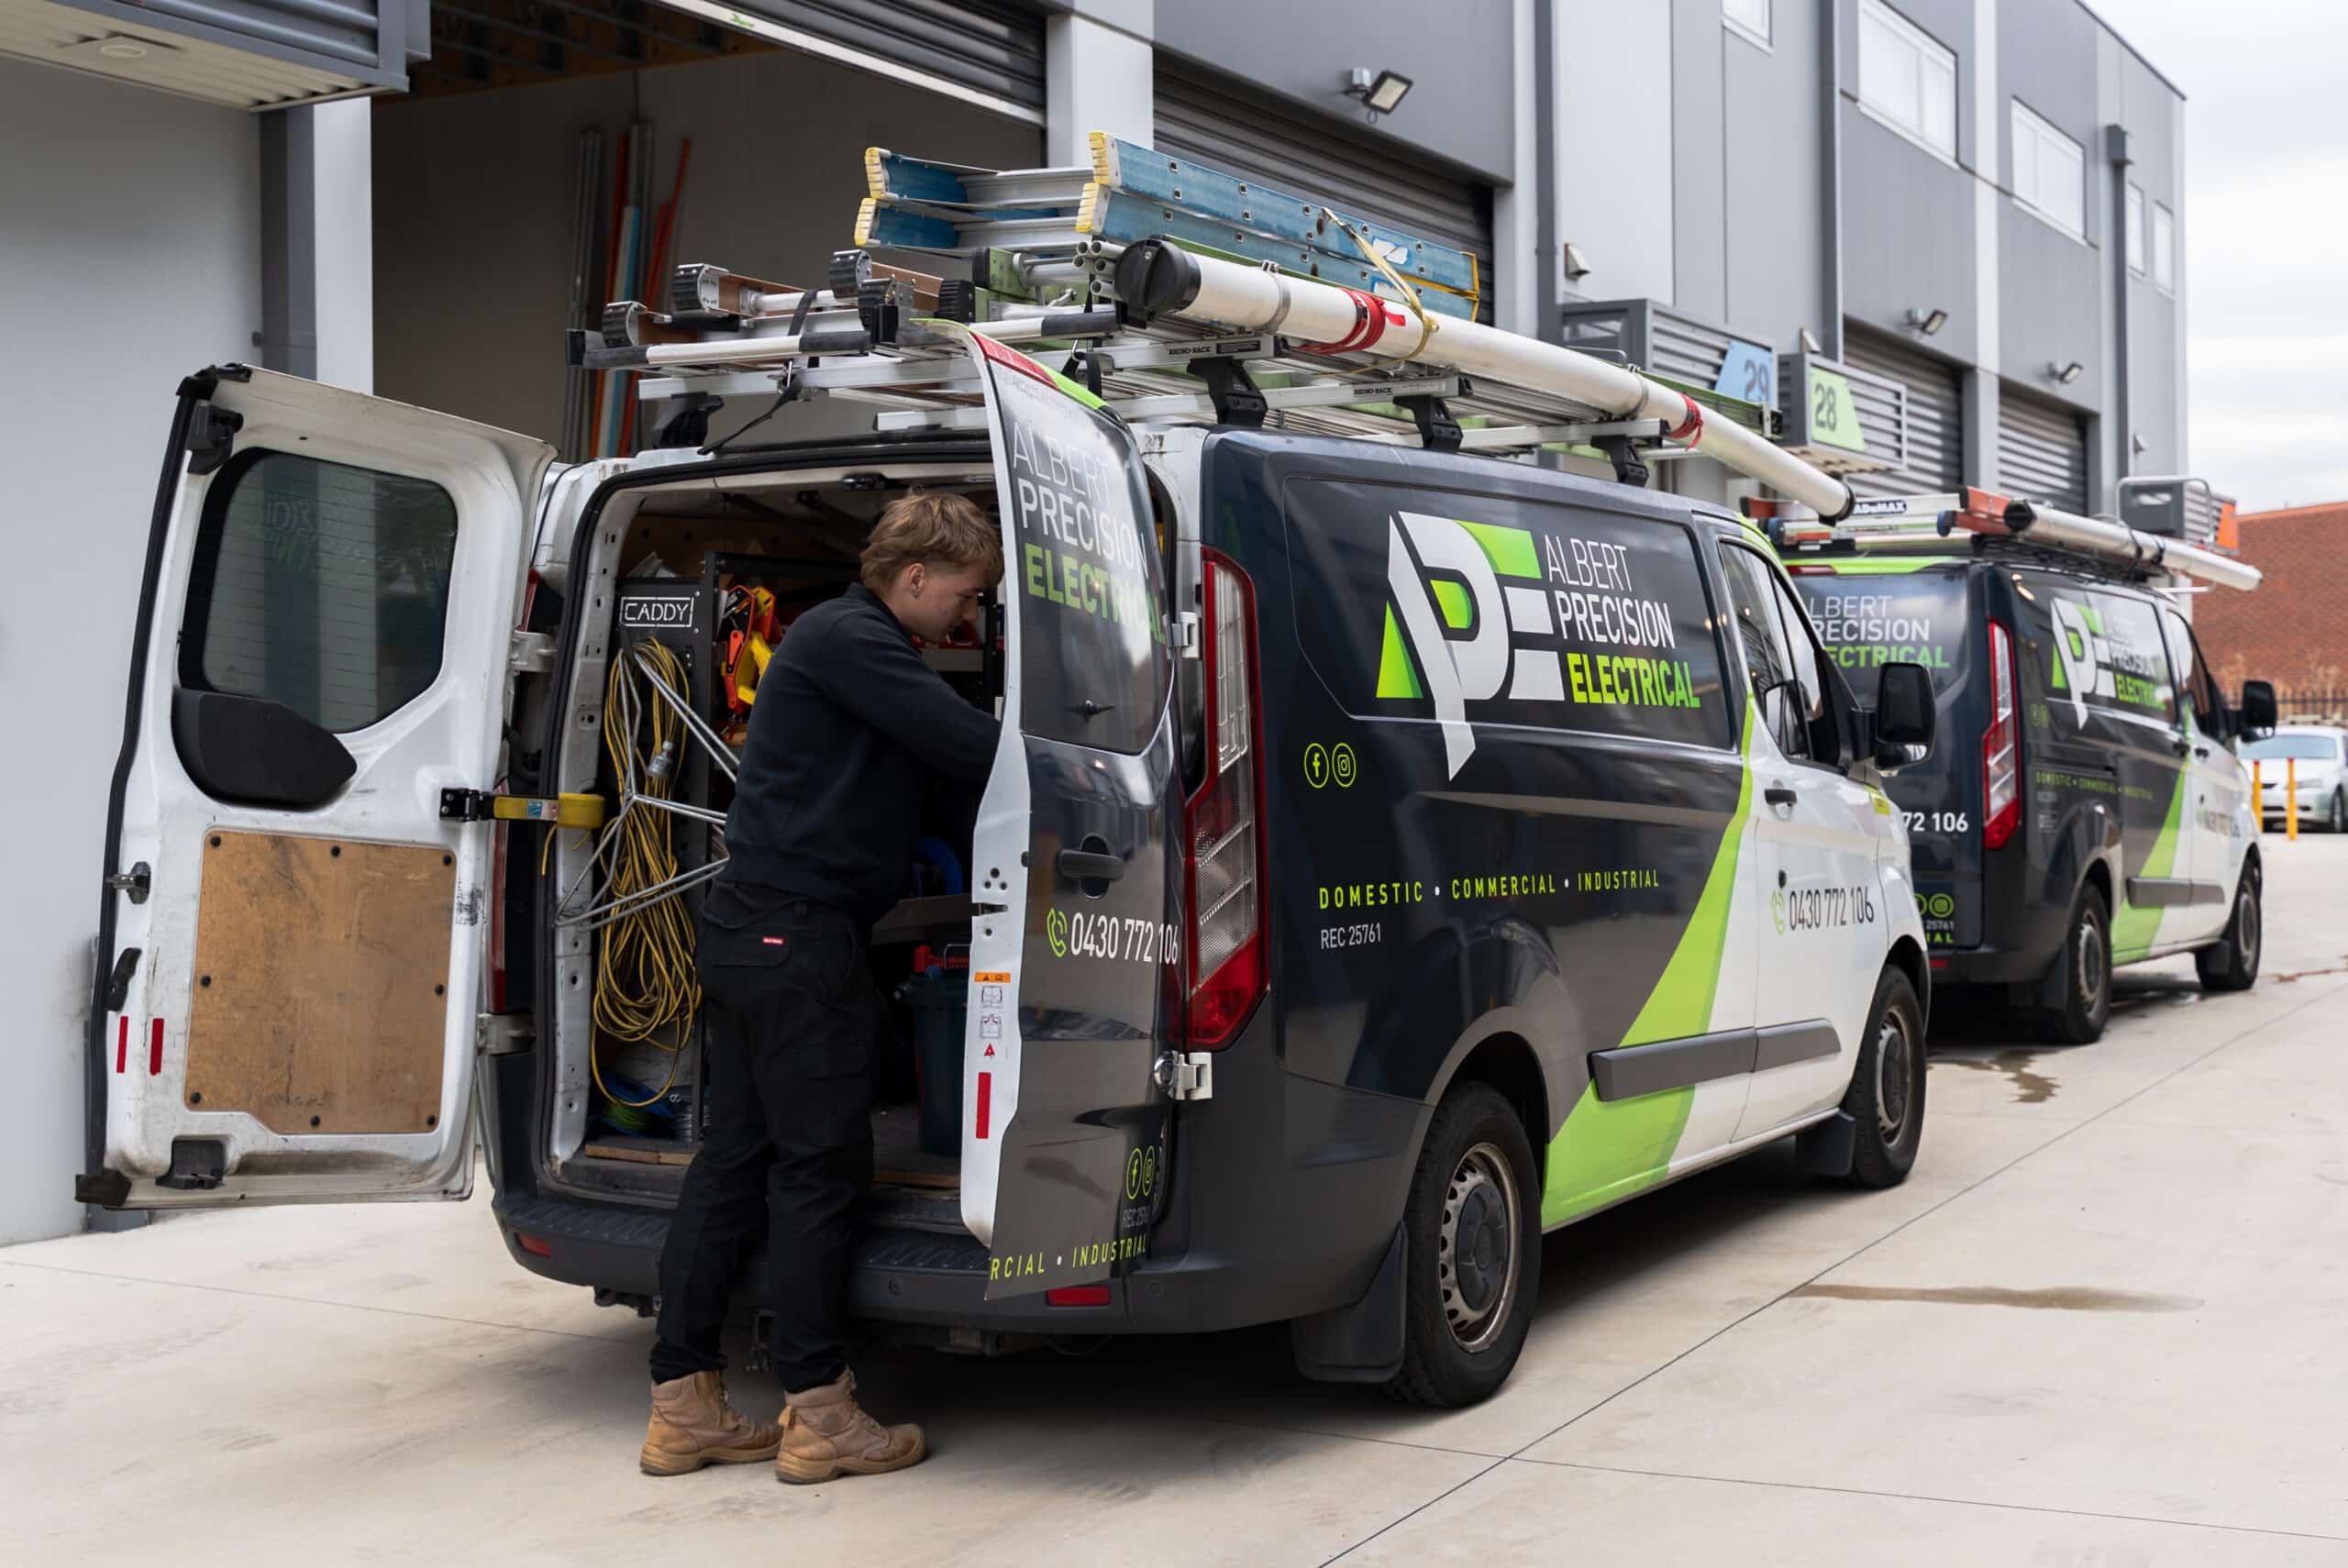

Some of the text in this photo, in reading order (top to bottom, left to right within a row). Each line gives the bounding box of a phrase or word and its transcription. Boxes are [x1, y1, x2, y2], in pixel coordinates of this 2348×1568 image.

[1744, 359, 1769, 403] 29
[1814, 382, 1837, 433] 28
[1013, 421, 1109, 505] ALBERT
[1017, 478, 1149, 580] PRECISION
[1545, 534, 1633, 592] ALBERT
[624, 602, 689, 622] CADDY
[1554, 590, 1676, 649] PRECISION
[1811, 594, 1894, 618] LBERT
[1813, 619, 1931, 642] RECISION
[1567, 652, 1701, 708] ELECTRICAL
[1901, 812, 1968, 832] 72 106
[1319, 868, 1660, 910] DOMESTIC COMMERCIAL INDUSTRIAL
[1789, 885, 1876, 932] 0430 772 106
[1070, 911, 1179, 965] 0430 772 106
[1320, 922, 1381, 950] REC 25761
[990, 1232, 1146, 1281] RCIAL INDUSTRIAL
